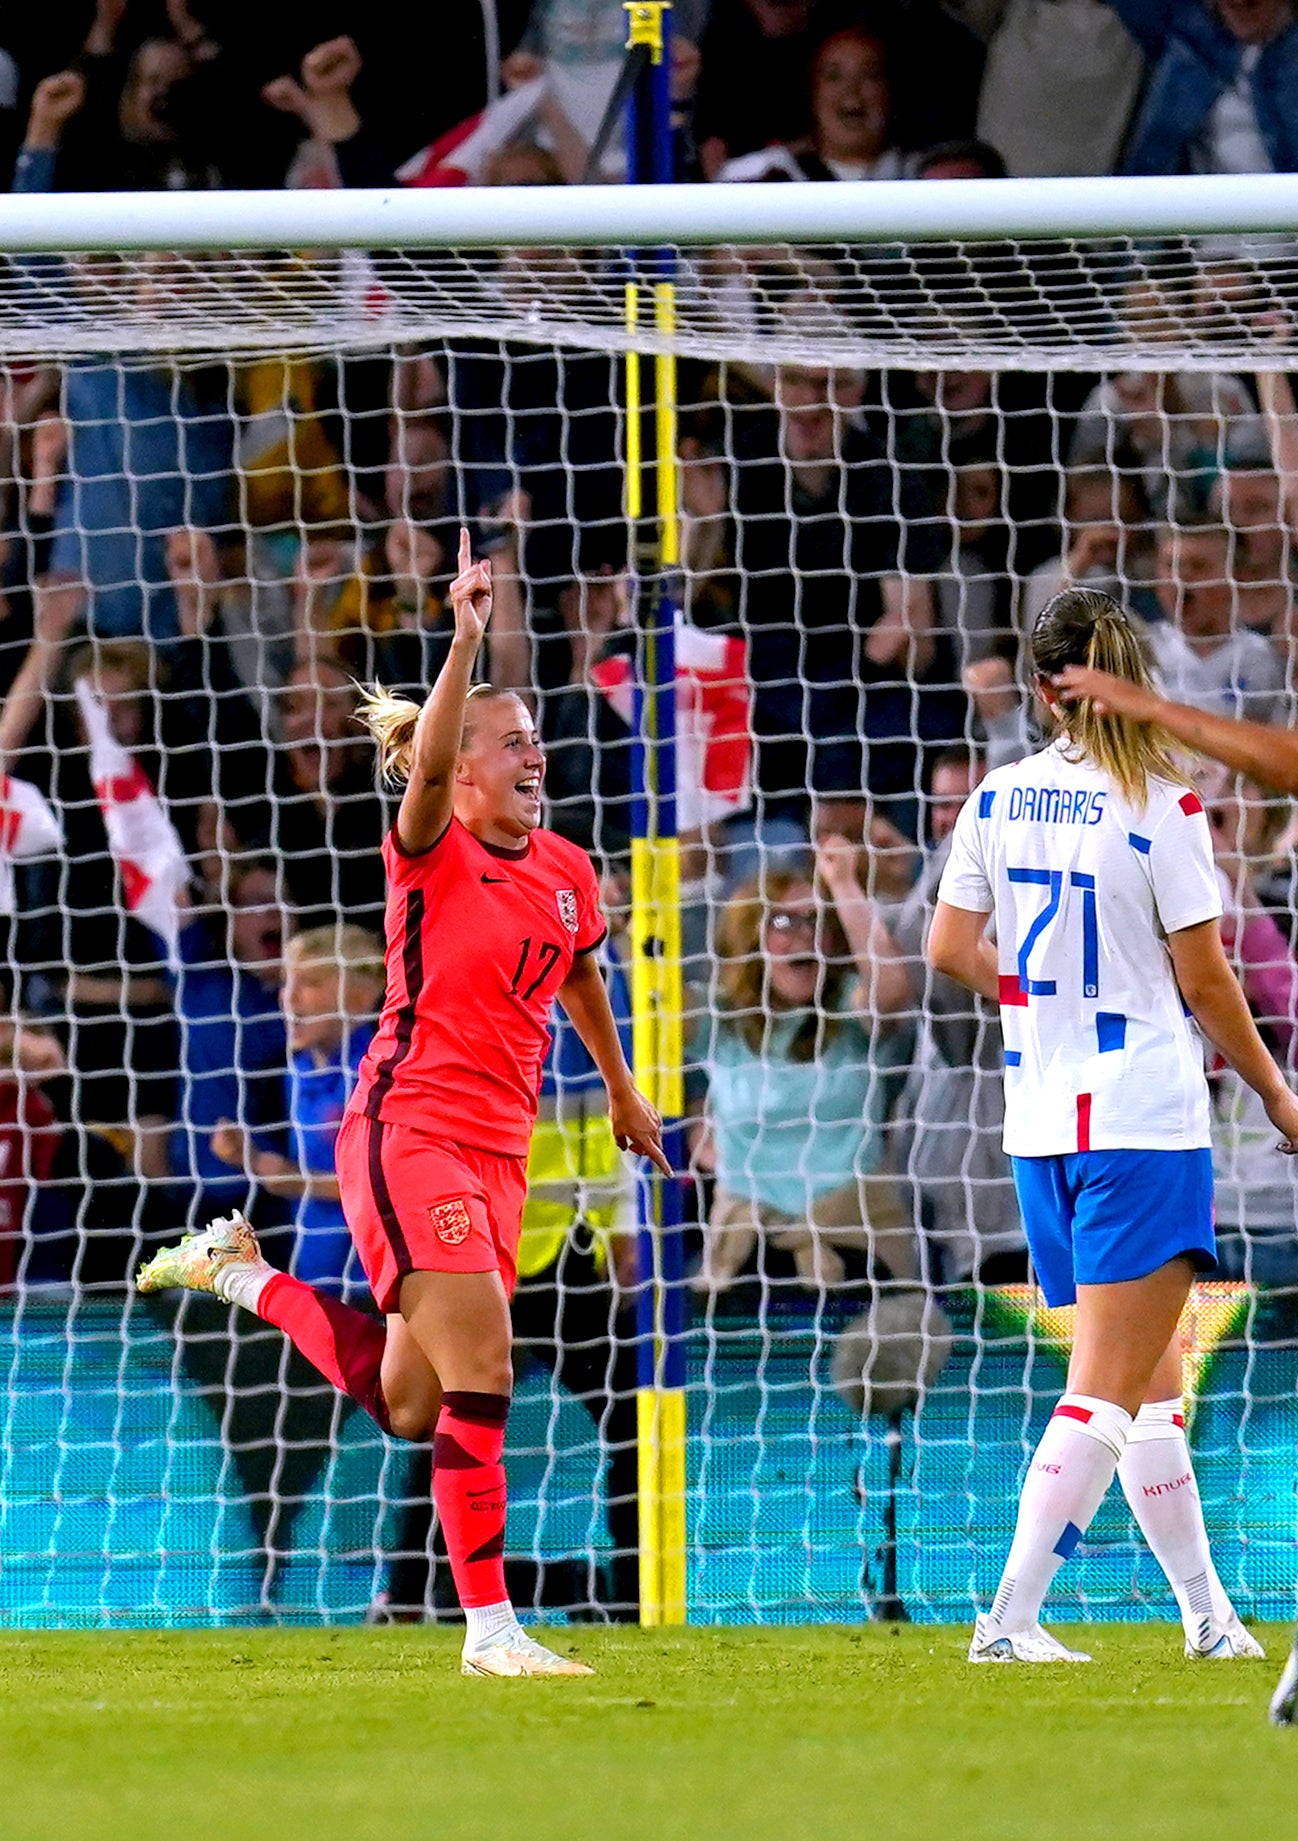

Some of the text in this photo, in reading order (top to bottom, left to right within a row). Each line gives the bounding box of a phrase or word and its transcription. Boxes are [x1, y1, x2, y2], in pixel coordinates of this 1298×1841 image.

[1009, 786, 1108, 826] DAMARIS
[1006, 867, 1099, 998] 21
[508, 936, 562, 1001] 17
